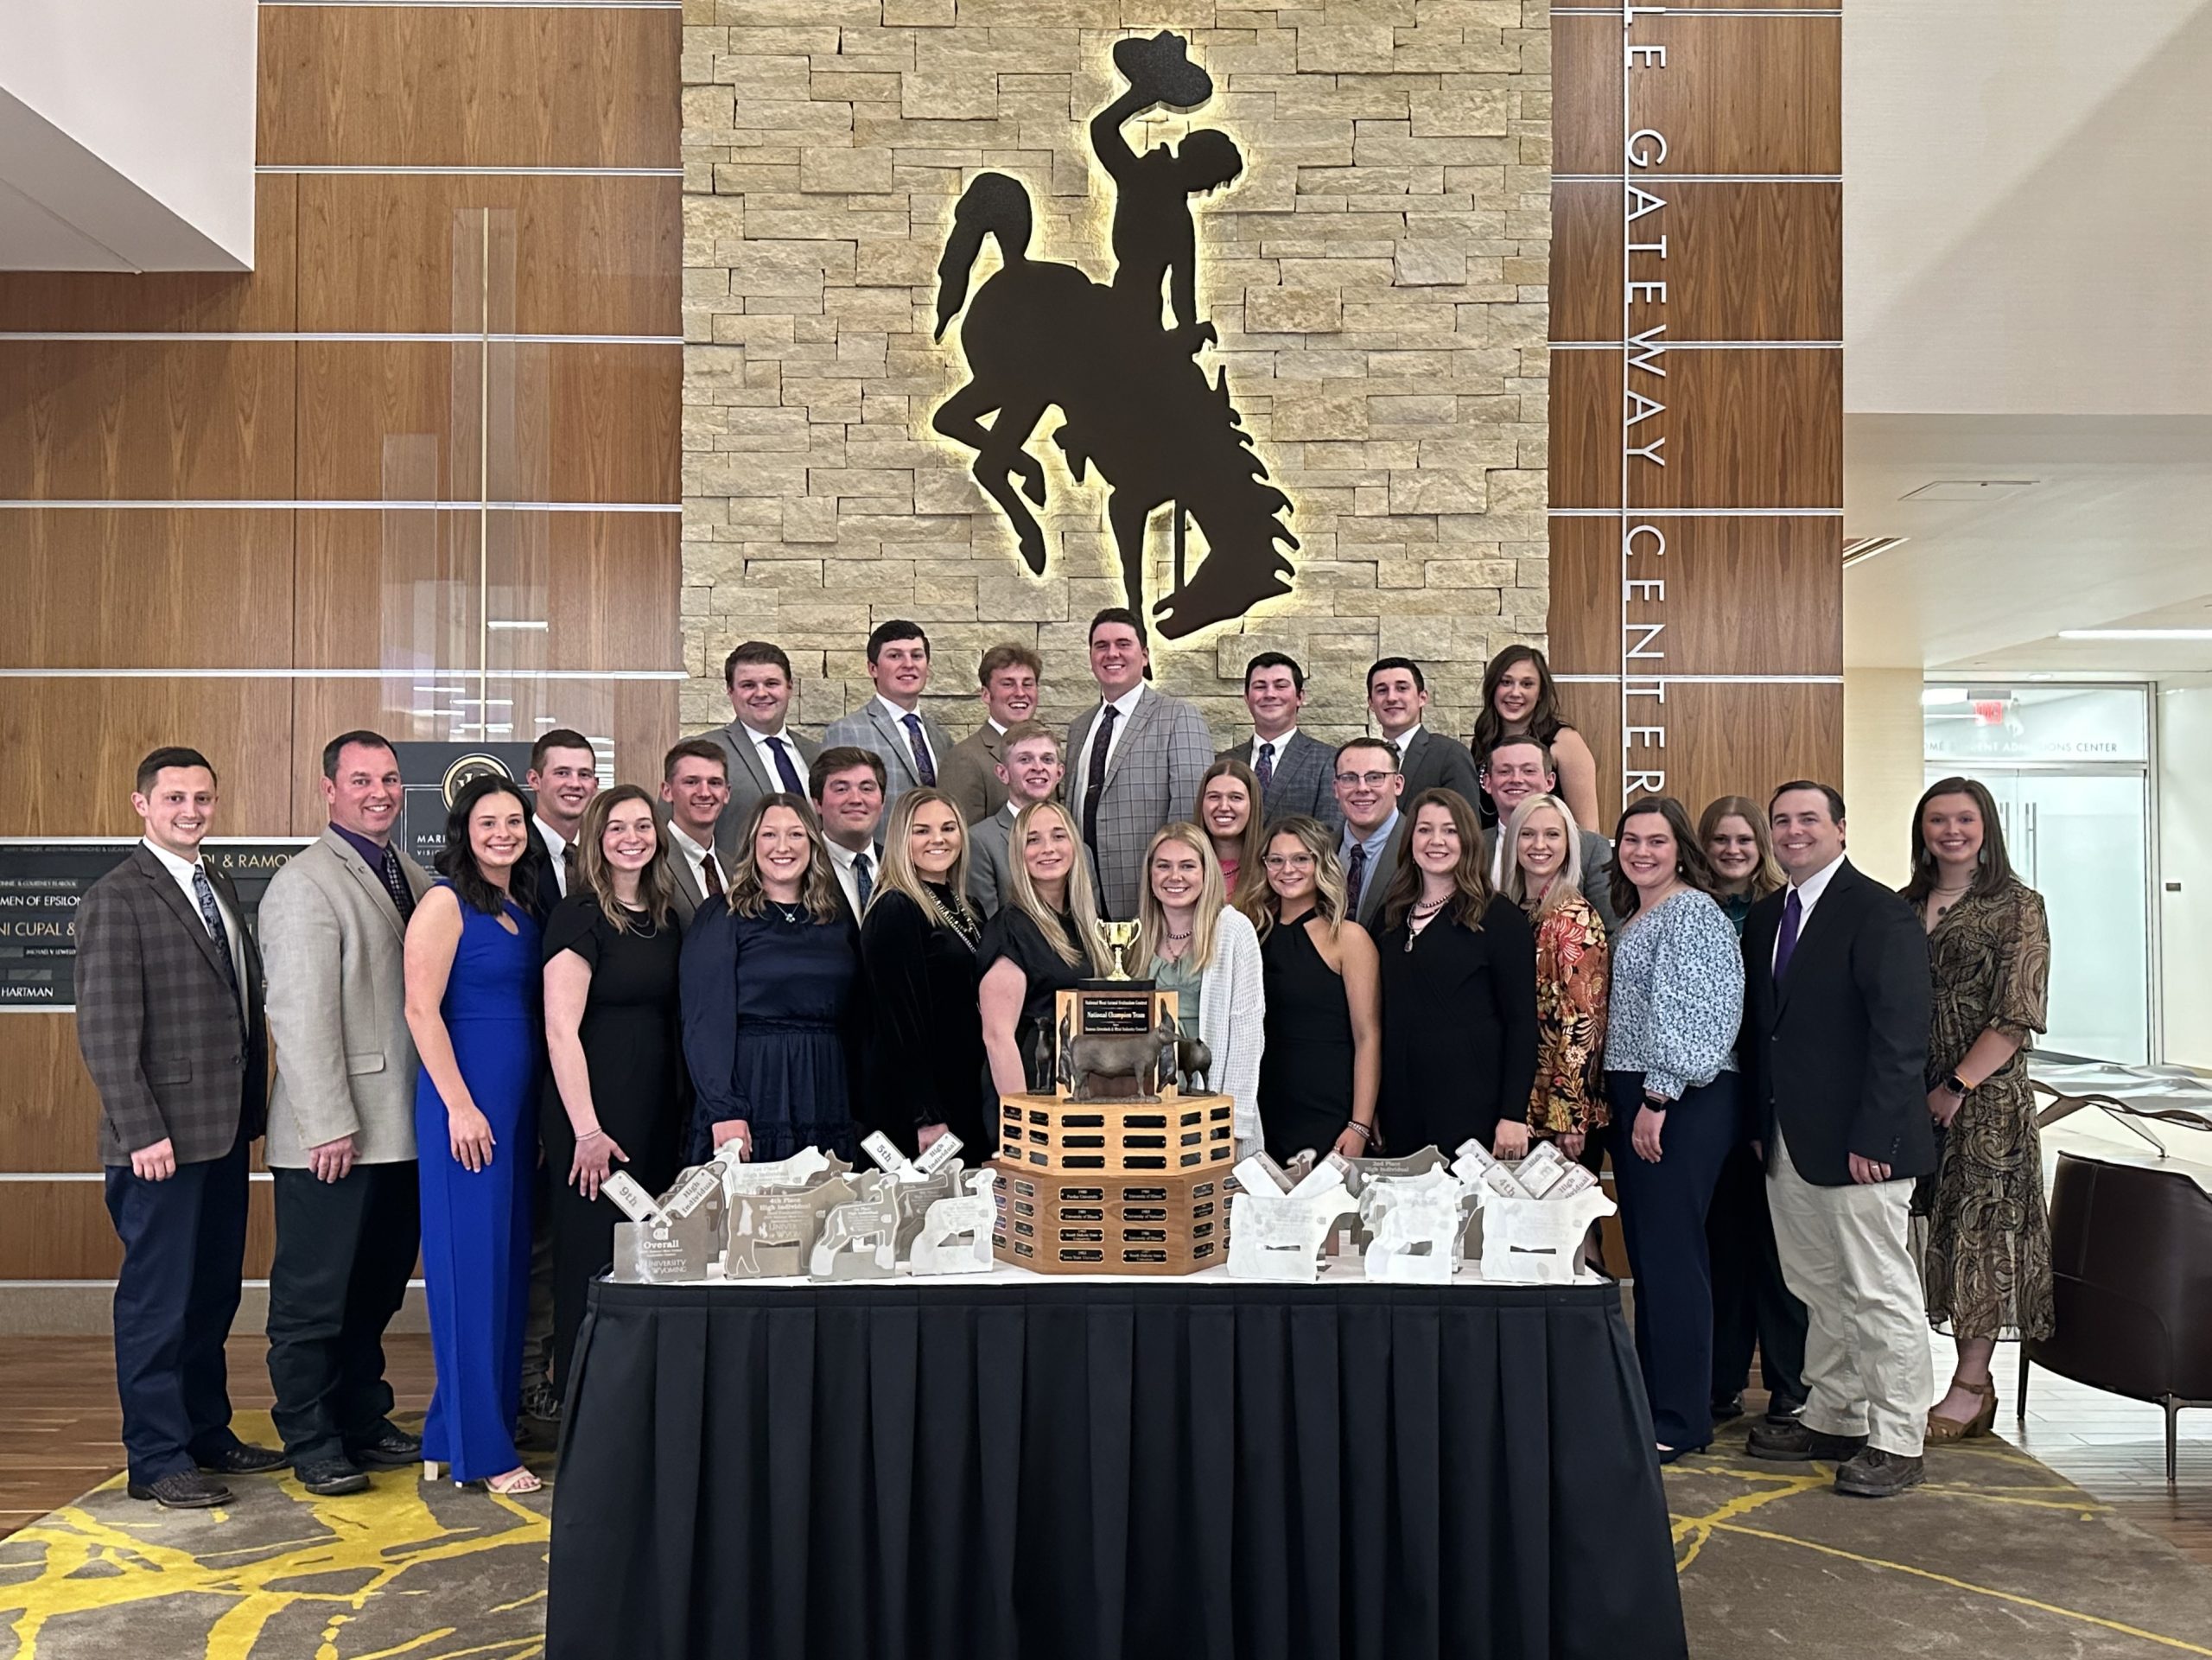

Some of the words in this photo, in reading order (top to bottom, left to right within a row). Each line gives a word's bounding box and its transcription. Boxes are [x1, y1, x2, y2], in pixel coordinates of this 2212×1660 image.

[1624, 128, 1669, 467] GATEWAY
[1623, 524, 1669, 793] CENTER
[2075, 741, 2118, 753] CENTER
[222, 854, 233, 868] &
[238, 853, 293, 868] RAMO
[0, 895, 24, 906] MEN
[26, 895, 41, 906] OF
[15, 921, 62, 937] CUPAL
[67, 921, 75, 937] &
[1, 987, 54, 998] HARTMAN
[1108, 1011, 1132, 1020] Champion
[876, 1144, 892, 1162] 5th
[927, 1142, 957, 1170] Individual
[929, 1143, 944, 1158] High
[682, 1180, 700, 1199] High
[1498, 1178, 1516, 1197] 4th
[1558, 1177, 1575, 1194] High
[620, 1186, 639, 1207] 9th
[682, 1178, 715, 1213] Individual
[643, 1239, 680, 1250] Overall
[651, 1266, 687, 1275] WYOMING
